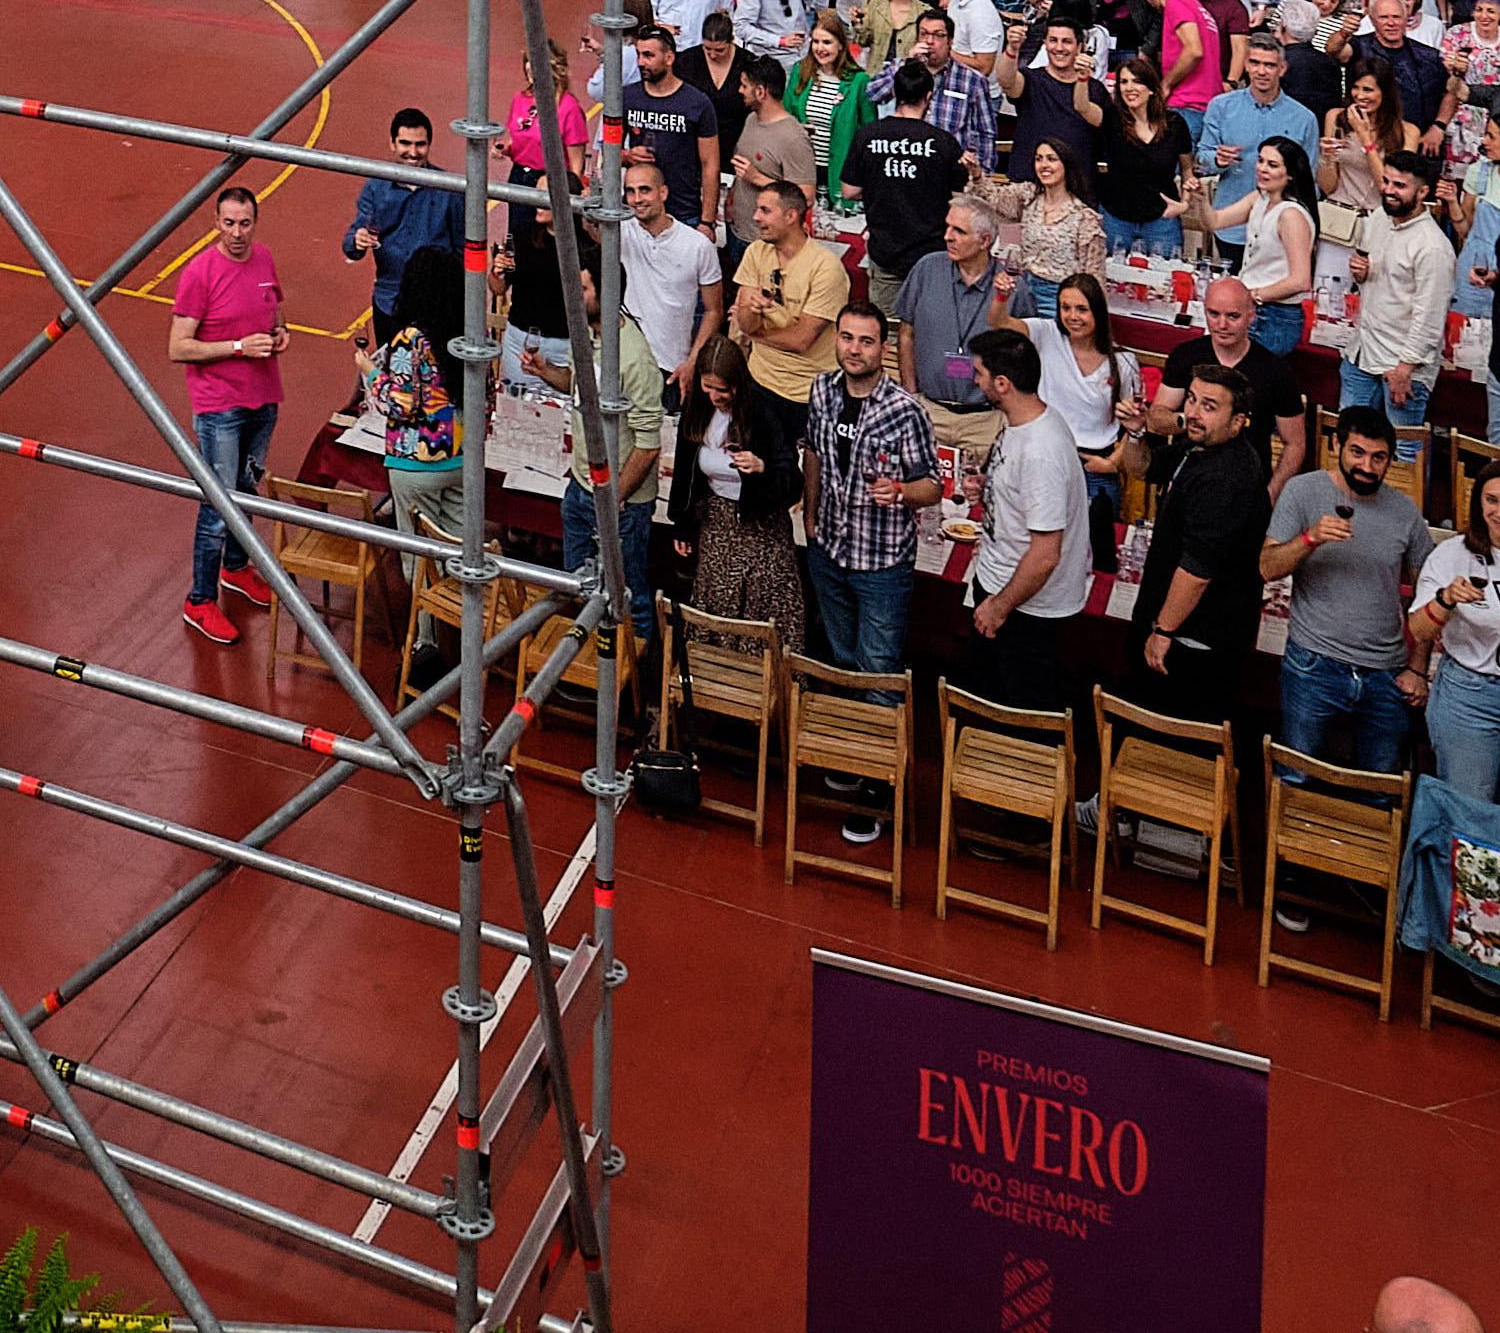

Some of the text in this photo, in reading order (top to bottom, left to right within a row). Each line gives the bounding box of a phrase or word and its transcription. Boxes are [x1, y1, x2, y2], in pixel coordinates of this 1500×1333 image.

[628, 110, 686, 126] HILFIGER
[867, 138, 937, 158] metal
[884, 156, 917, 179] life
[977, 1049, 1088, 1096] PREMIOS
[917, 1066, 1149, 1198] ENVERO
[949, 1162, 1113, 1226] 1000 SIEMPRE
[972, 1191, 1088, 1241] ACIERTAN
